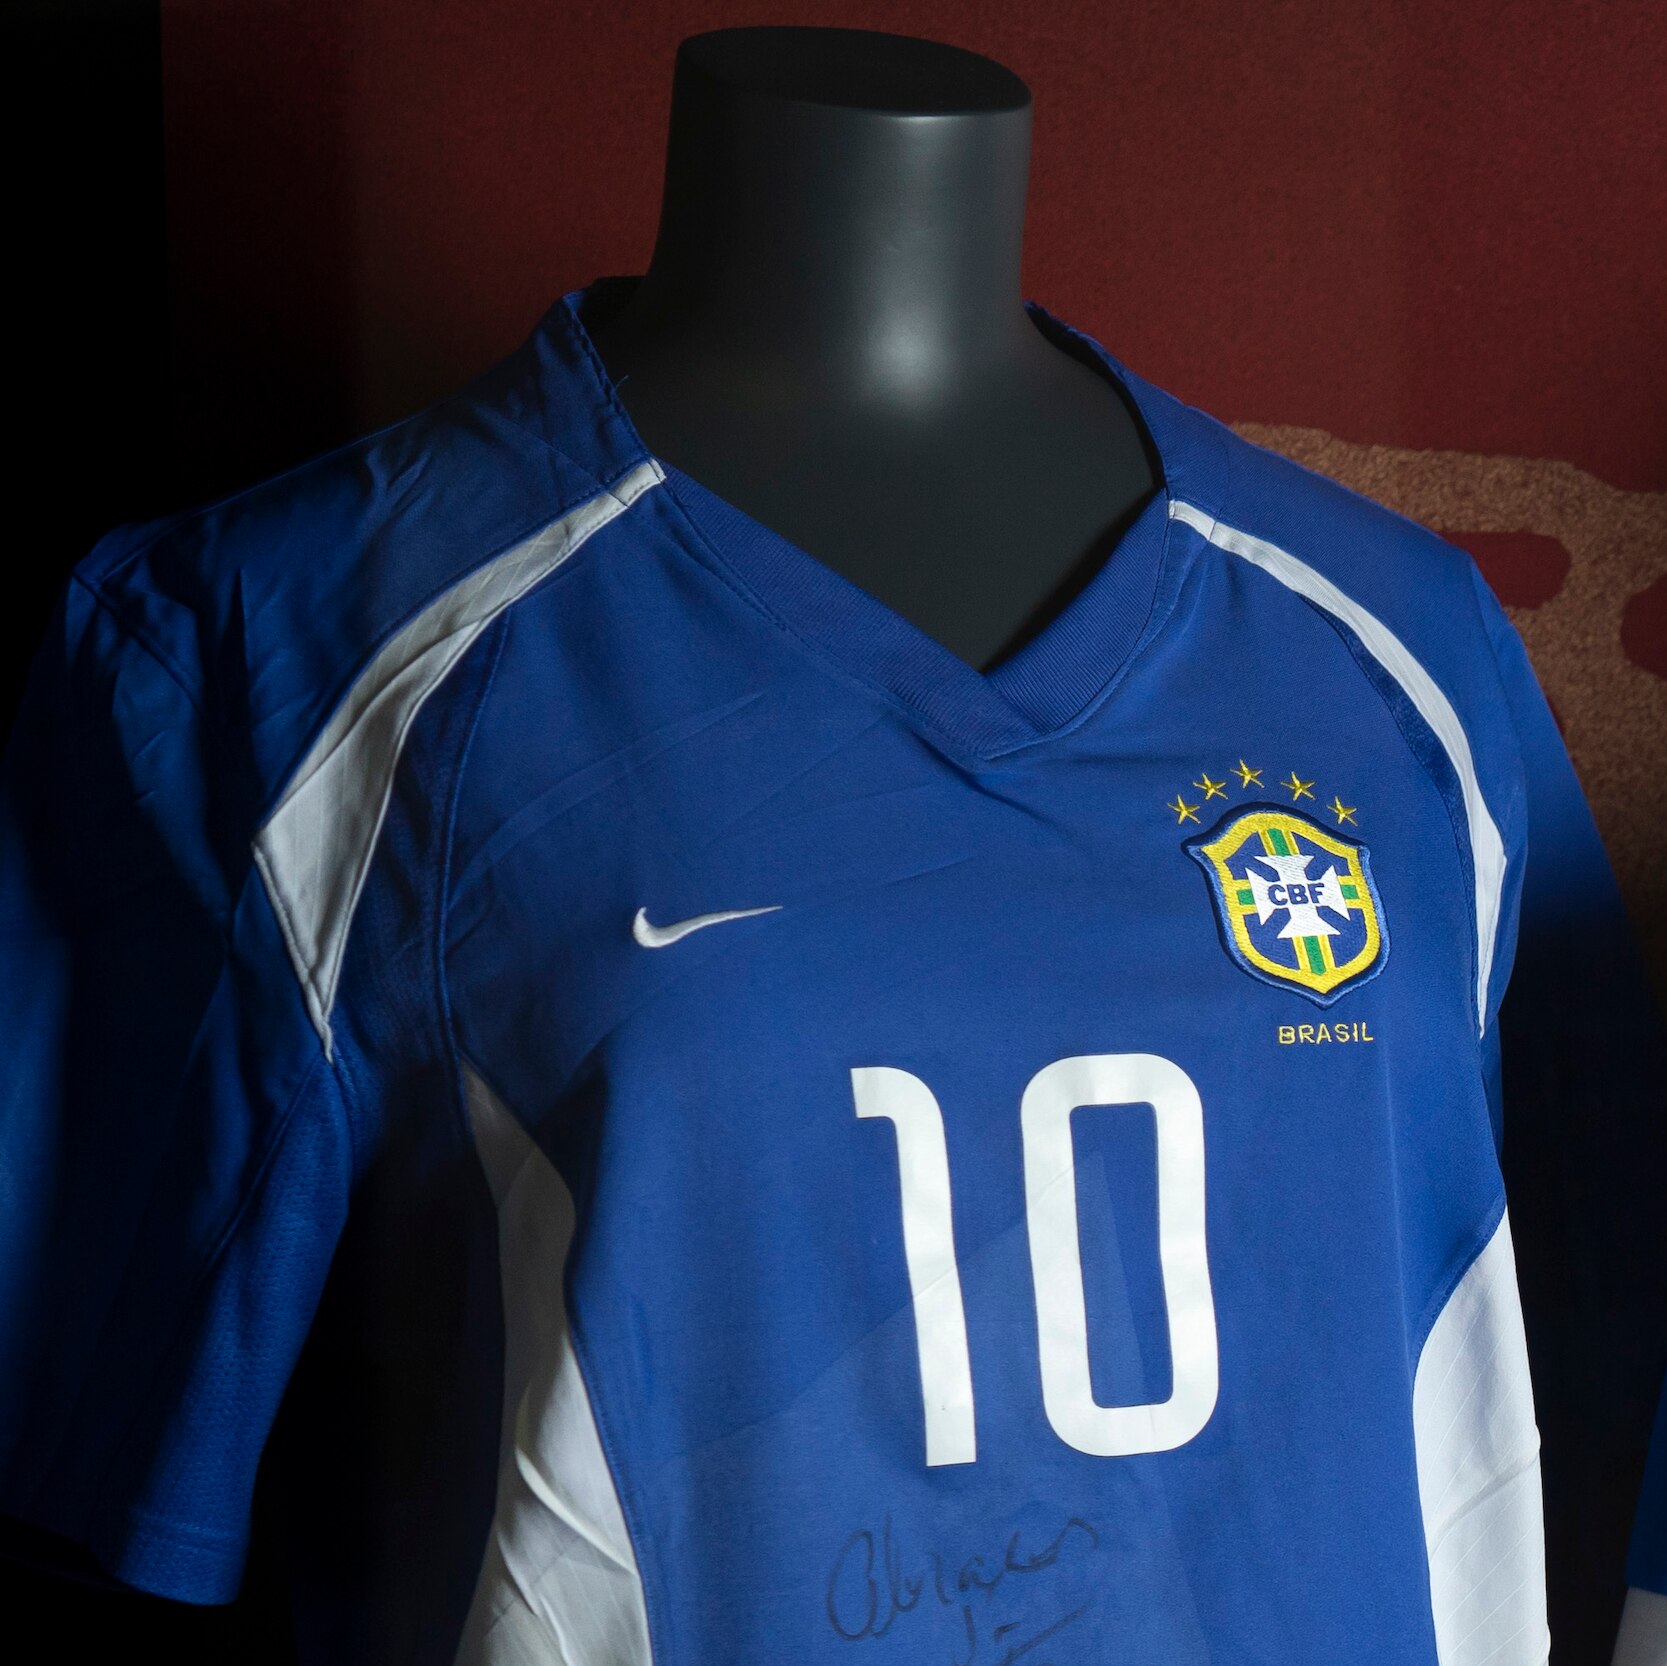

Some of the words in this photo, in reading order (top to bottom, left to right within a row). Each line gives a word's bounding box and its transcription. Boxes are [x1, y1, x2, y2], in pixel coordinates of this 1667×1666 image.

[1267, 882, 1325, 907] CBF
[1278, 1022, 1374, 1045] BRASIL
[850, 1053, 1219, 1467] 10
